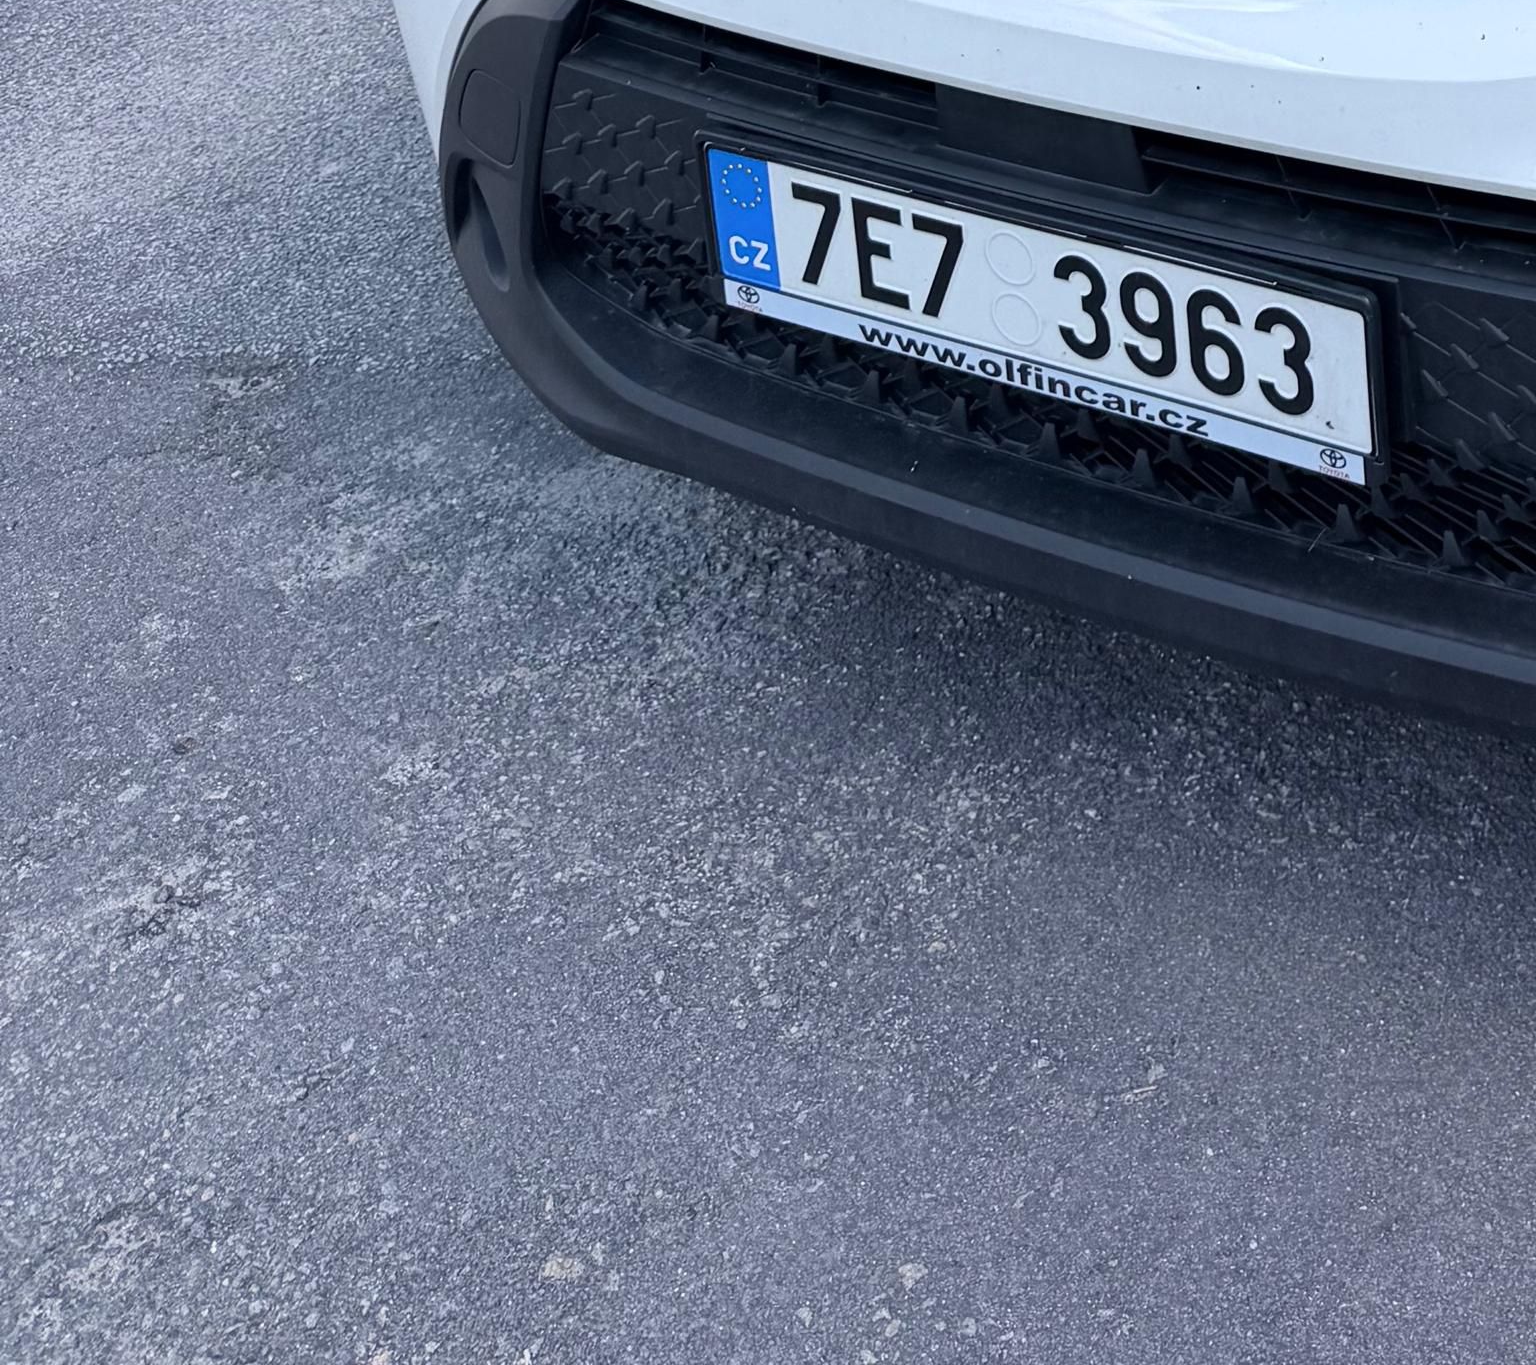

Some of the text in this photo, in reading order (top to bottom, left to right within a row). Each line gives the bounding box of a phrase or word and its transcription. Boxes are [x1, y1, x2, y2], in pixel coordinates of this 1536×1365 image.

[728, 235, 772, 271] CZ
[791, 181, 1315, 416] 7E7 3963
[858, 323, 1210, 437] www.olfincar.cz
